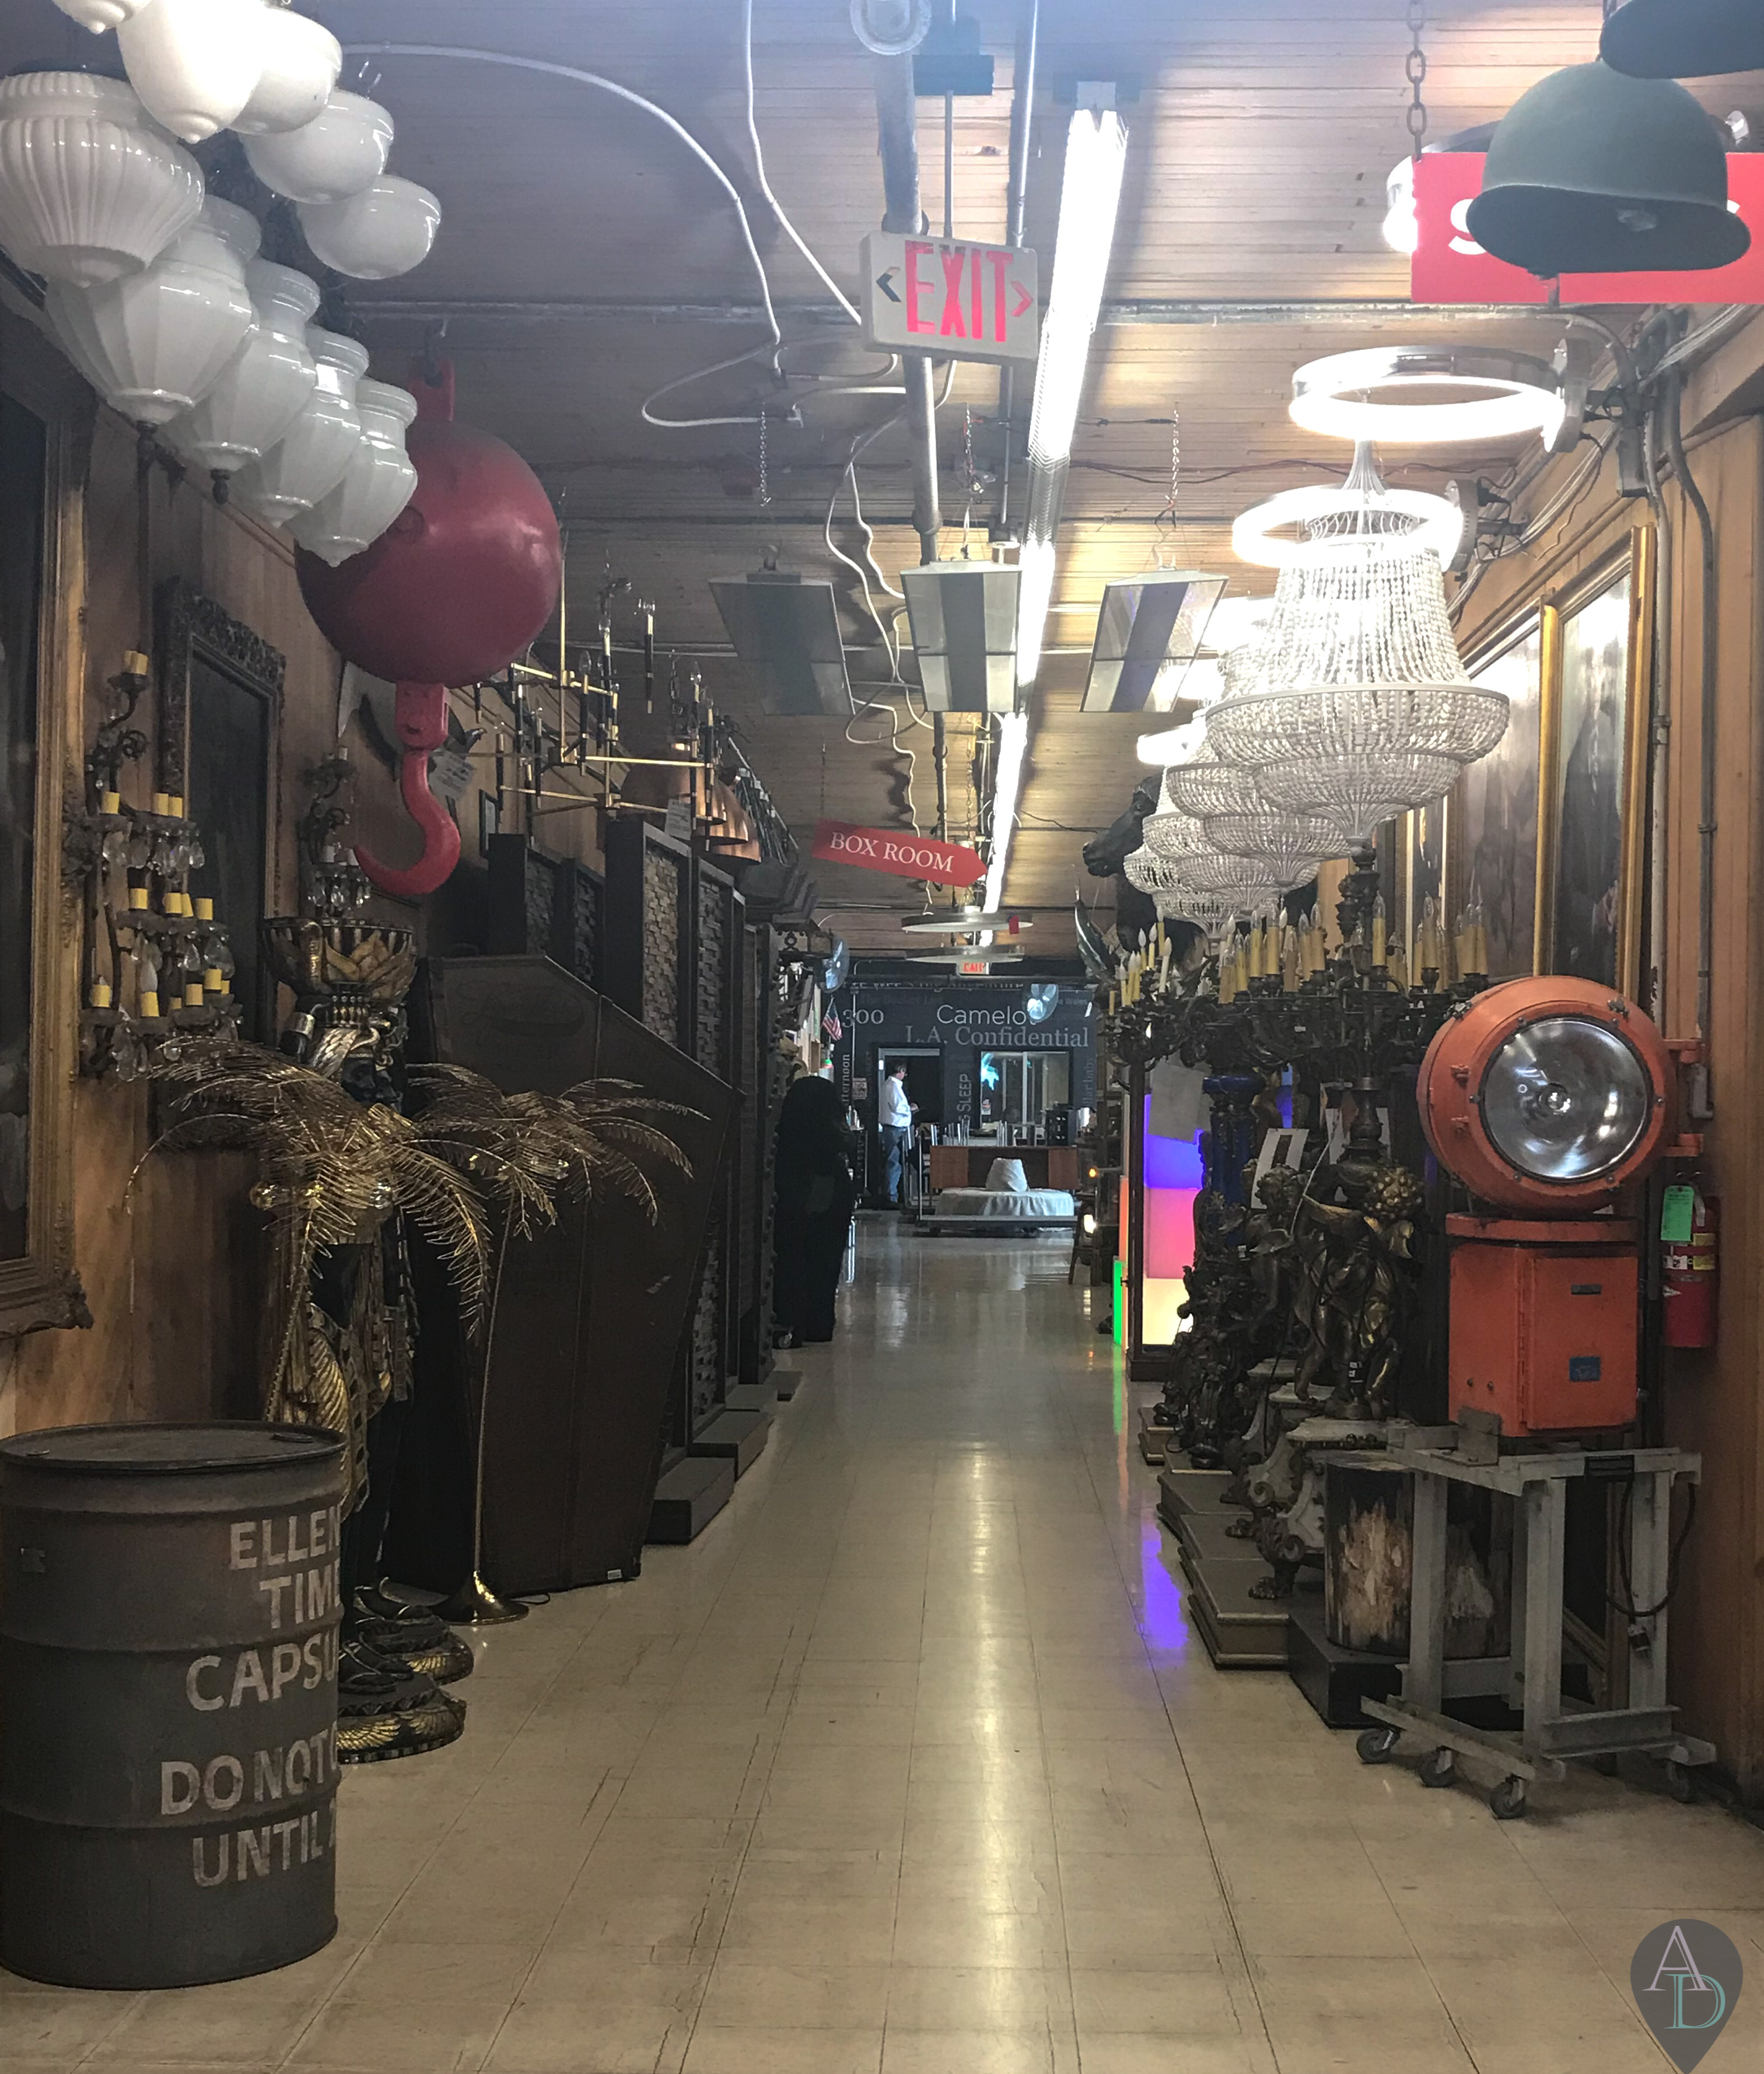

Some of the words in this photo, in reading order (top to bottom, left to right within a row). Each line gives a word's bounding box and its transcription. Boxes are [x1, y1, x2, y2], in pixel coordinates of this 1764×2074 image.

[905, 240, 1014, 342] EXIT
[830, 832, 878, 857] BOX
[884, 842, 954, 873] ROOM
[842, 1009, 884, 1028] 300
[937, 1004, 1036, 1025] Camelo
[955, 1025, 1089, 1047] Confidential
[841, 1054, 850, 1105] fternoon
[957, 1074, 972, 1112] SLEEP
[161, 1755, 244, 1814] DO
[254, 1729, 328, 1802] NOT
[192, 1810, 323, 1887] UNTIL
